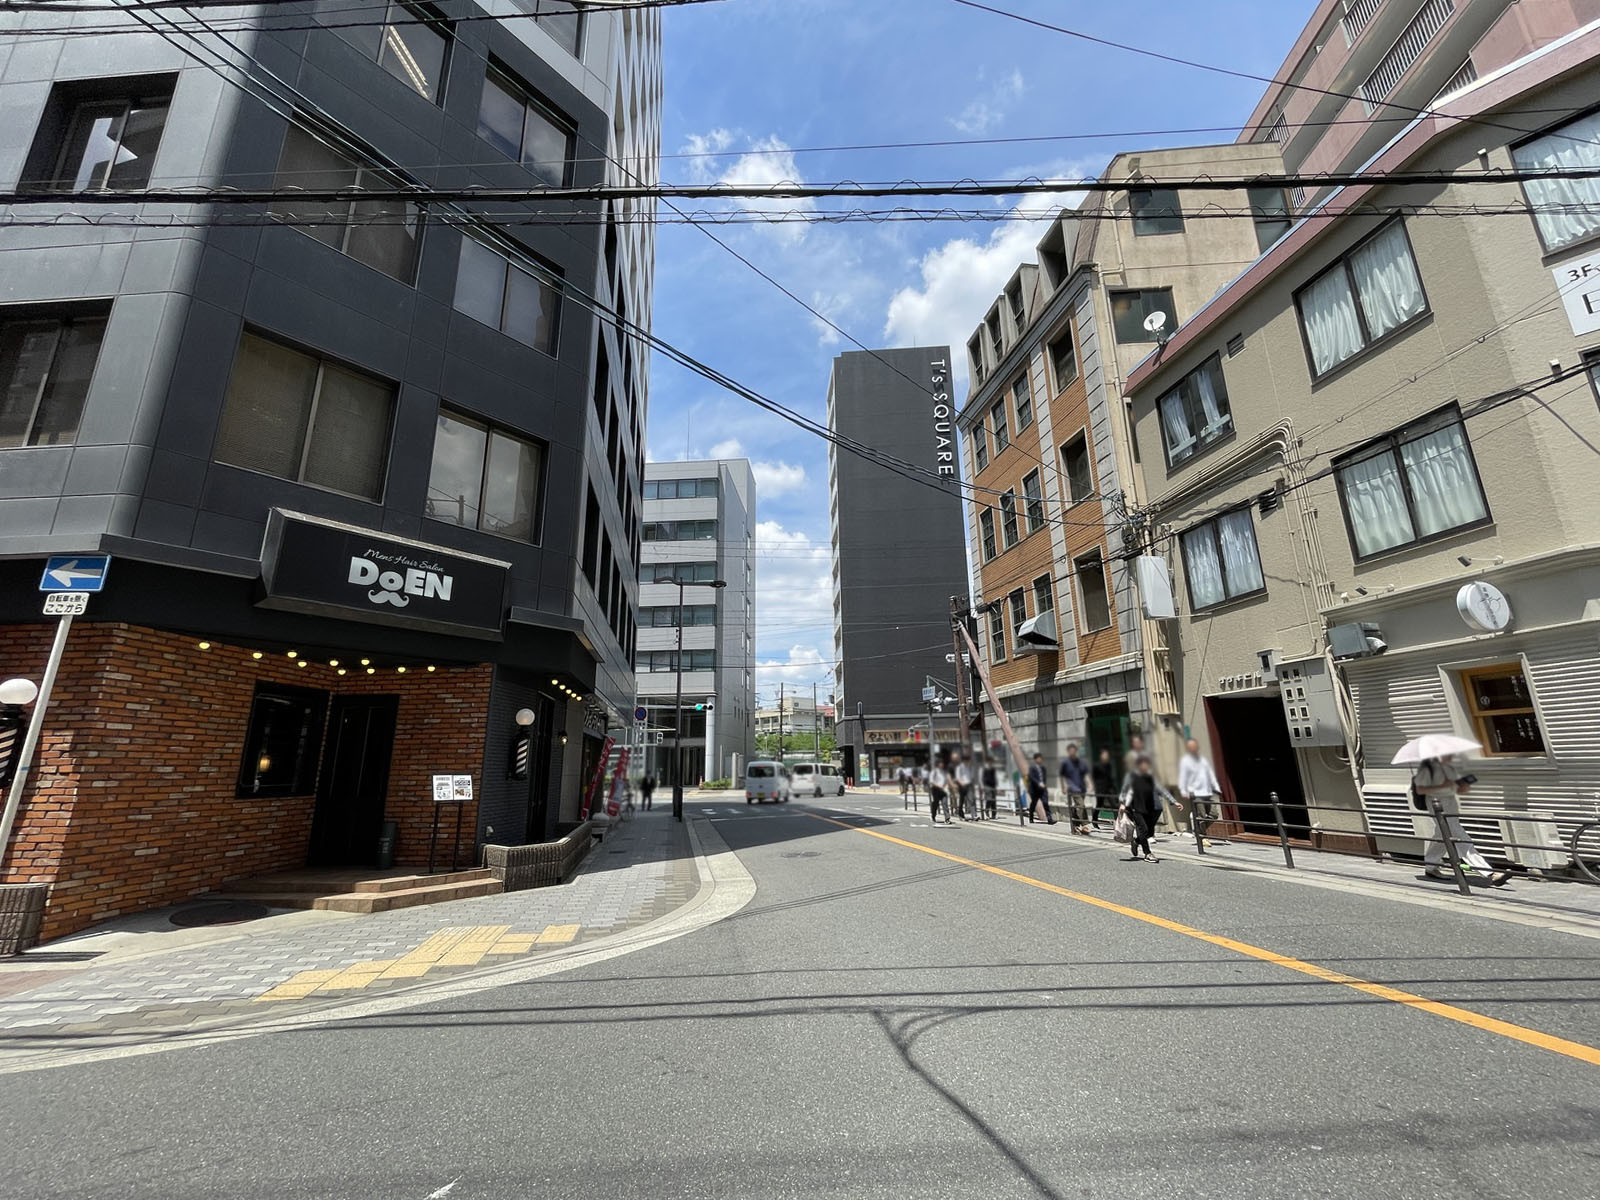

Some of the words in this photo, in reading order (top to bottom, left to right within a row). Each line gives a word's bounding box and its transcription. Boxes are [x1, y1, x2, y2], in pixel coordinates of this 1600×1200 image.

[932, 392, 954, 475] SQUARE
[363, 548, 394, 562] Mens
[394, 556, 418, 568] Hair
[418, 560, 445, 573] Salon
[45, 603, 83, 613] ここから
